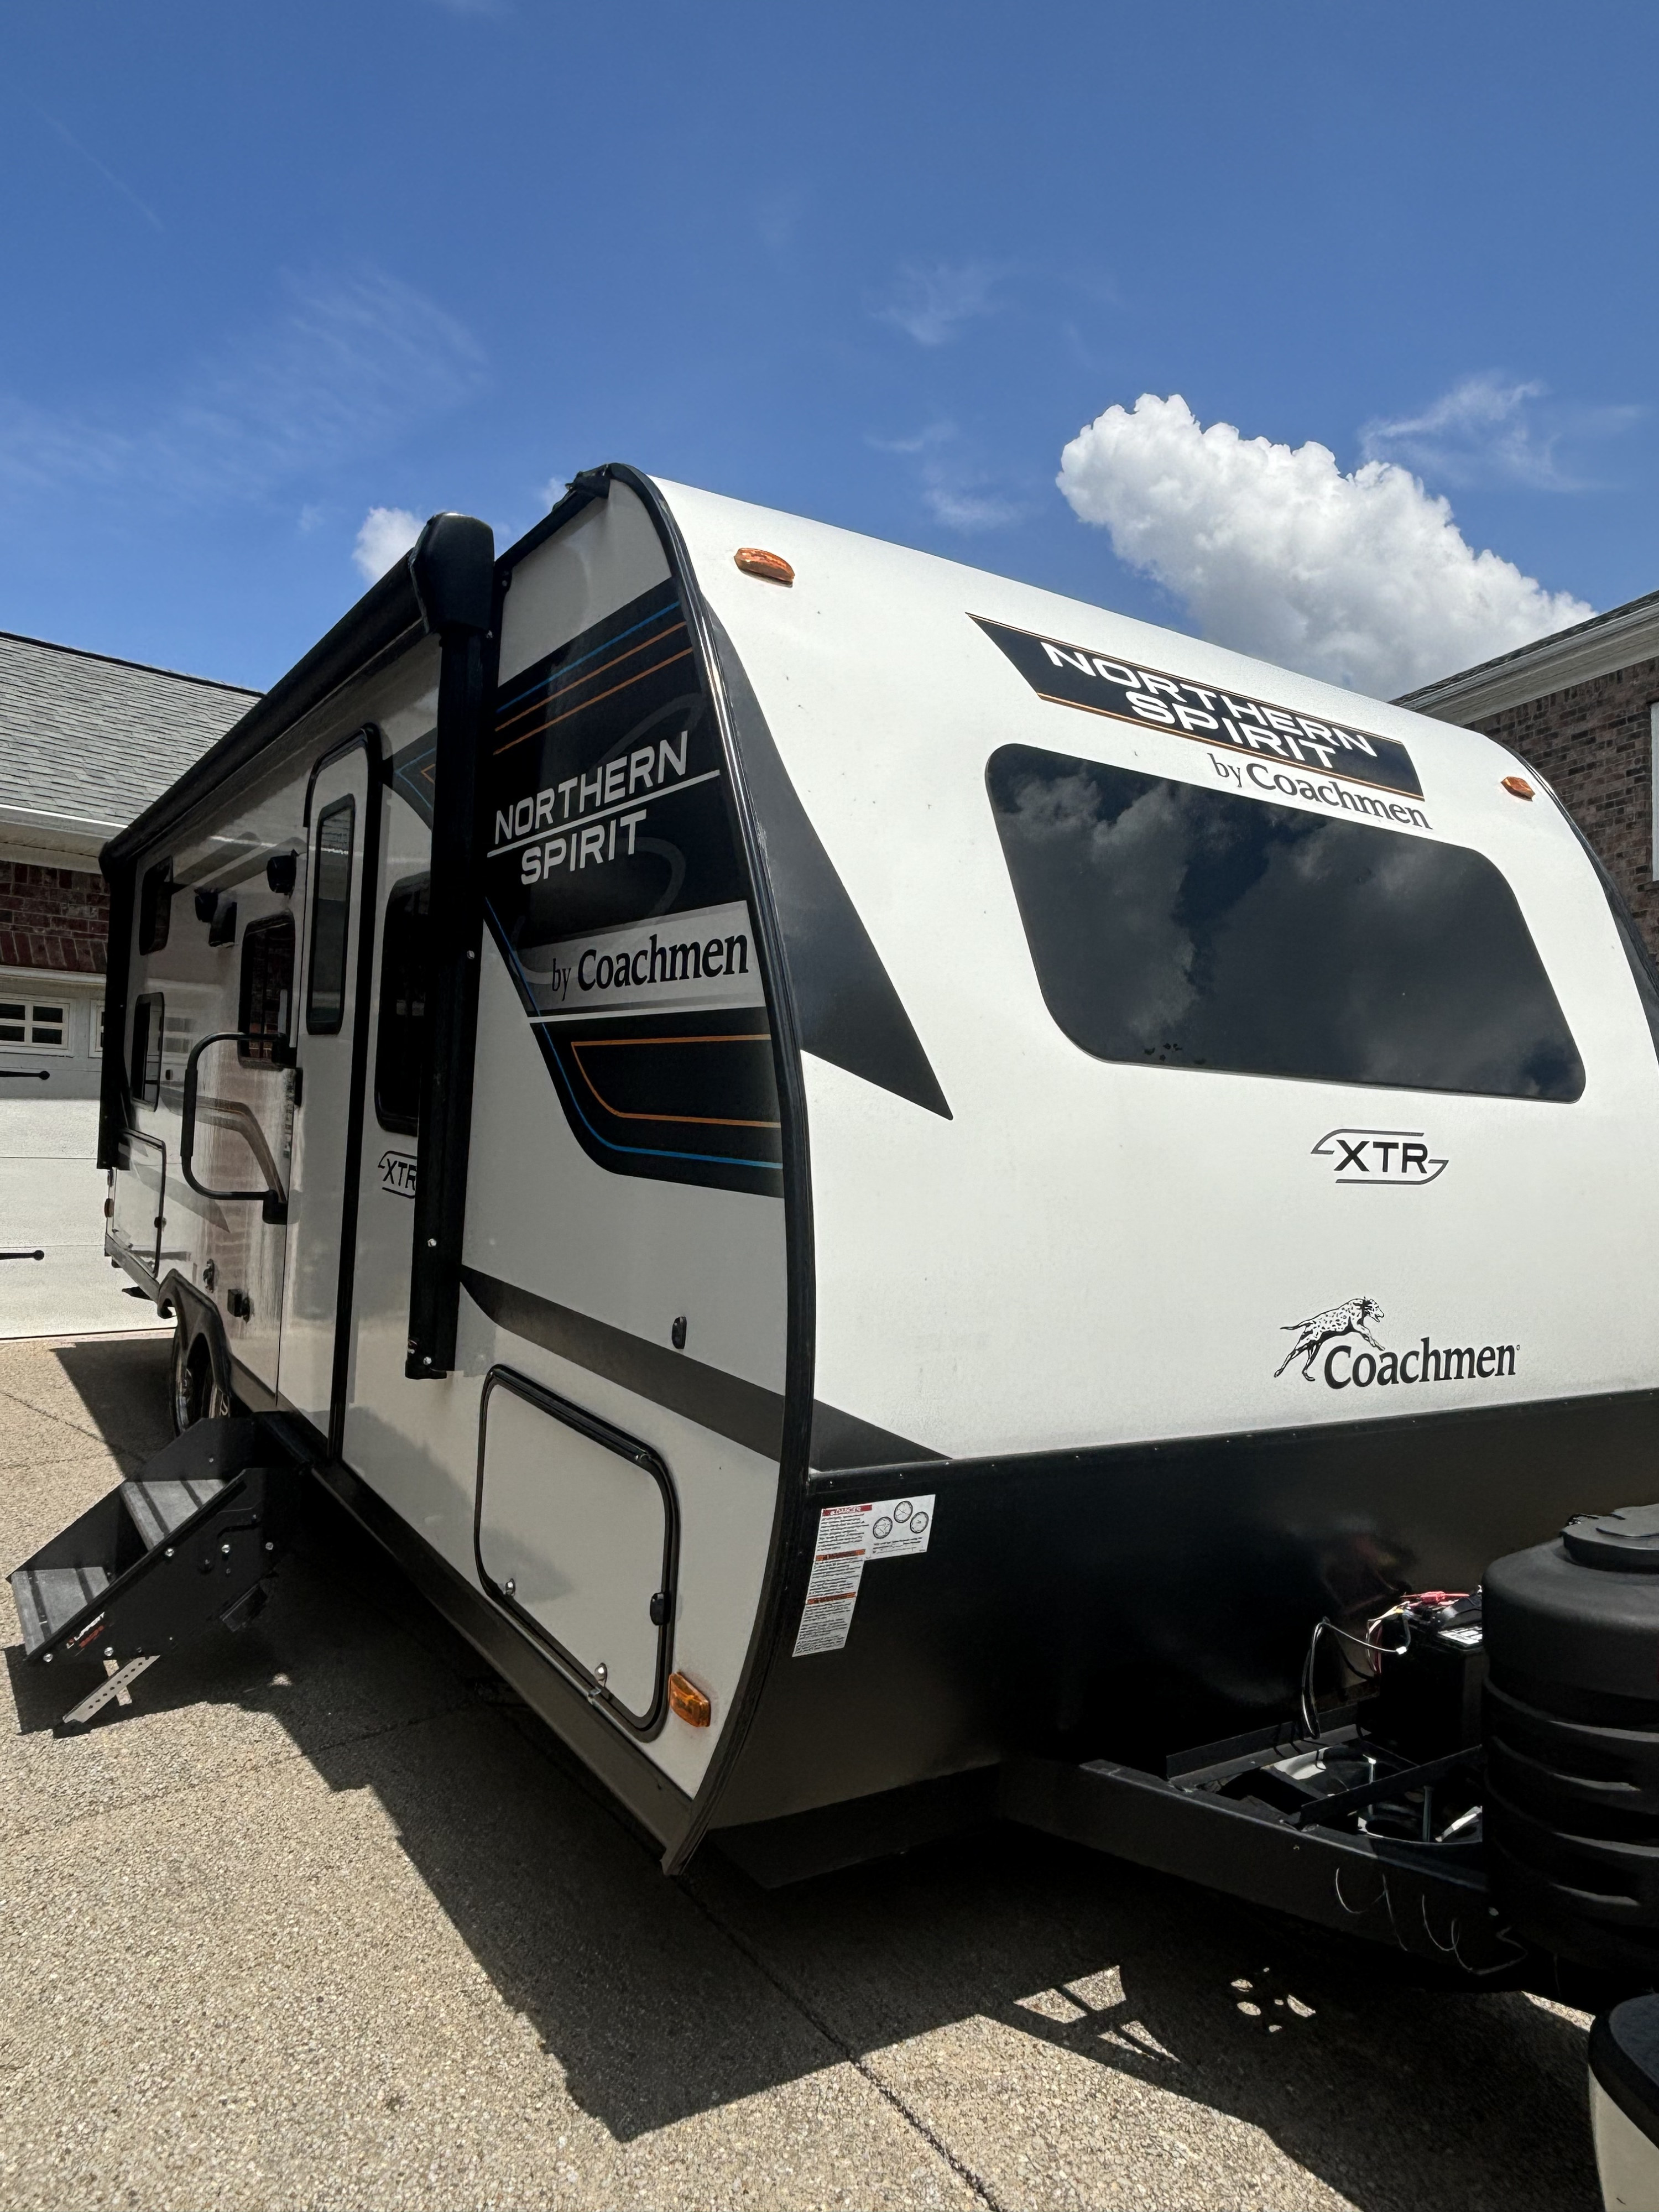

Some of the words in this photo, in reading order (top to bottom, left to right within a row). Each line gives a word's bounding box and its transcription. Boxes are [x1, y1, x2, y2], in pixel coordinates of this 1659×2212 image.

[1041, 641, 1377, 758] NORTHERN
[1125, 691, 1336, 770] SPIRIT
[494, 731, 688, 844] NORTHERN
[1208, 753, 1243, 788] by
[1246, 763, 1433, 830] Coachmen
[521, 809, 647, 885] SPIRIT
[551, 958, 572, 1001] by
[577, 933, 749, 991] Coachmen
[383, 1158, 417, 1191] XTR
[1333, 1139, 1429, 1174] XTR
[1323, 1337, 1516, 1390] Coachmen
